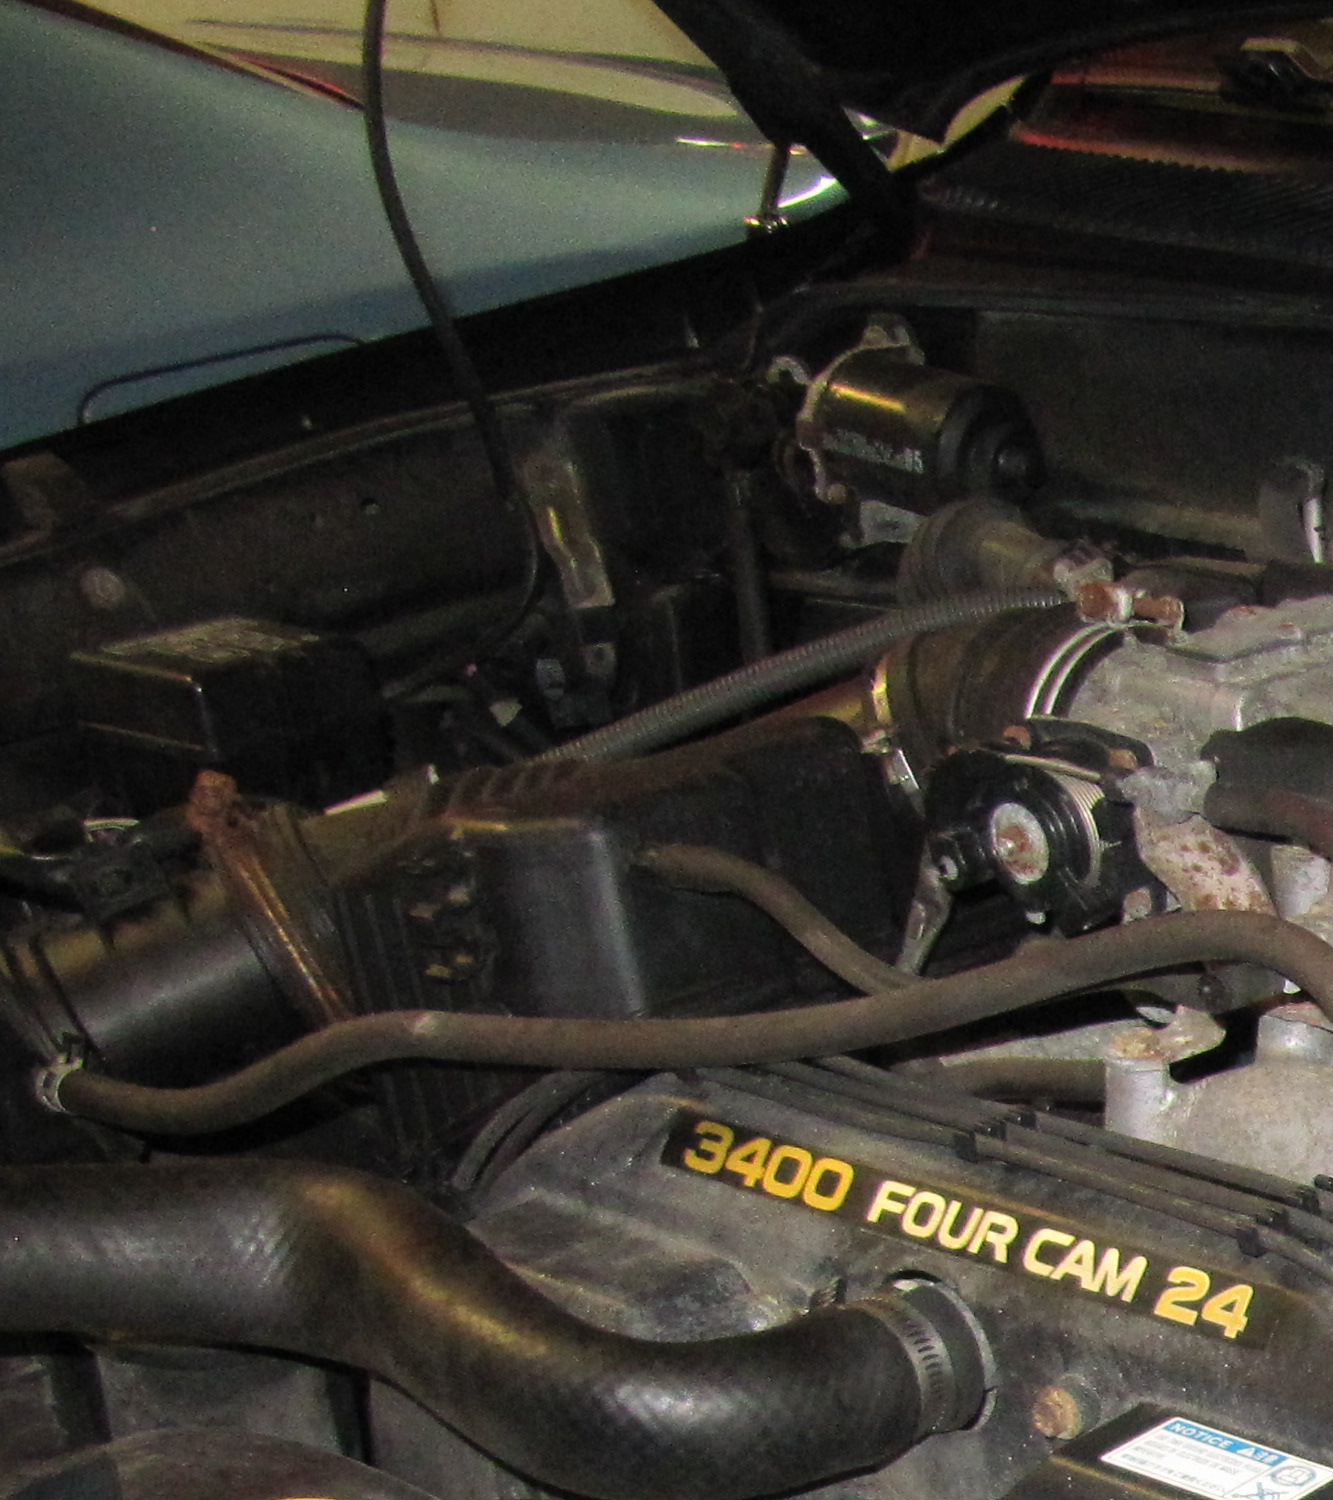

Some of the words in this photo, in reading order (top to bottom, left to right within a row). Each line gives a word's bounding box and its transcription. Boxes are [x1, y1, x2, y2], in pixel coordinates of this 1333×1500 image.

[683, 1120, 854, 1213] 3400
[867, 1180, 1019, 1265] FOUR
[1023, 1227, 1147, 1303] CAM
[1154, 1266, 1253, 1340] 24
[1166, 1423, 1235, 1448] NOTICE
